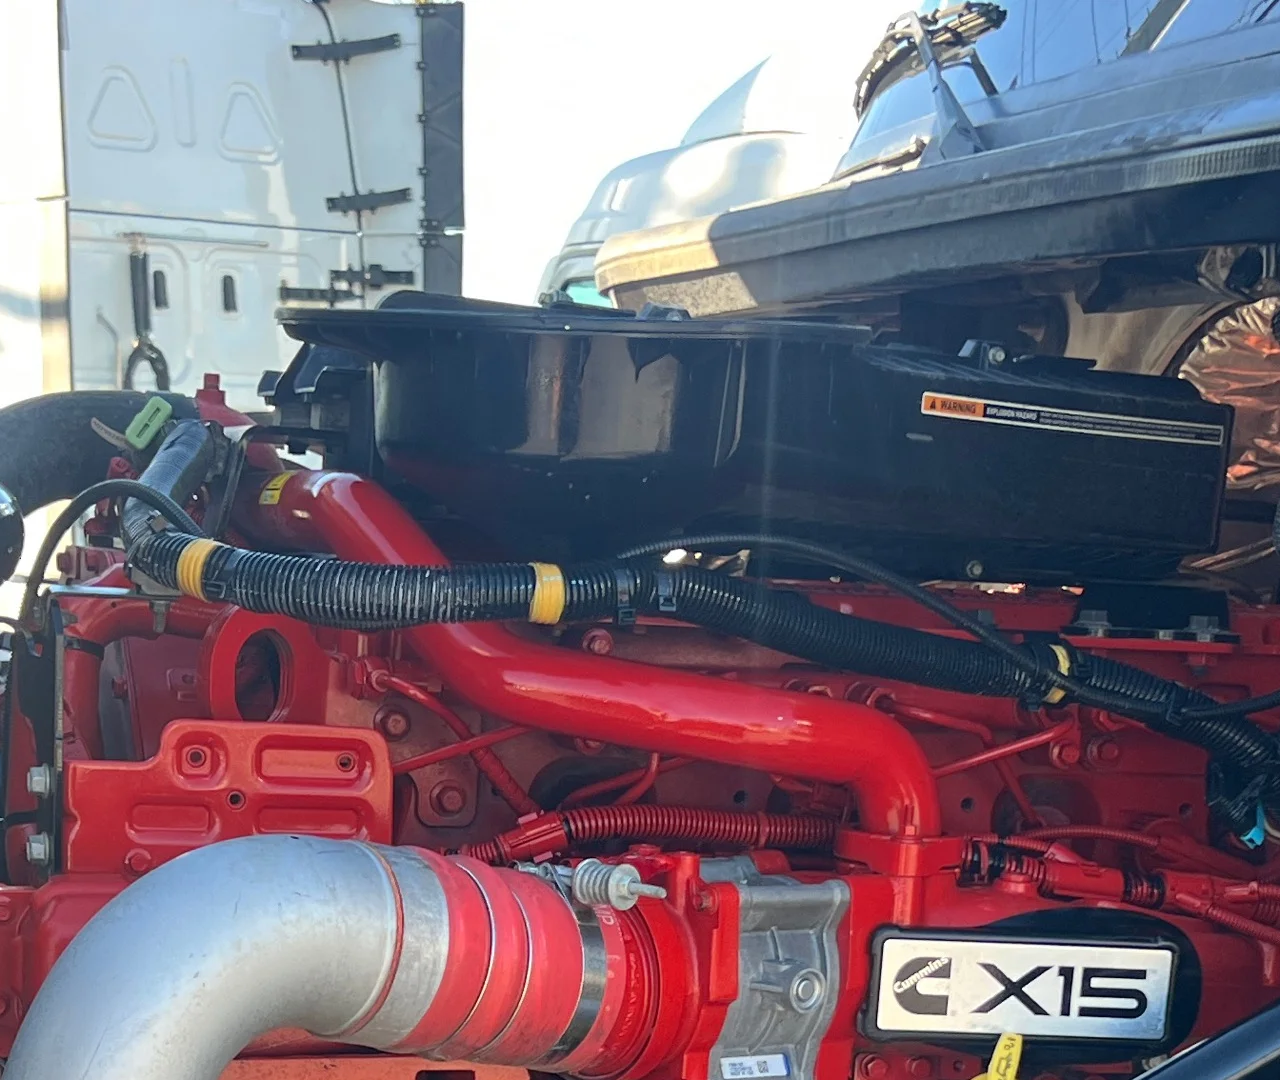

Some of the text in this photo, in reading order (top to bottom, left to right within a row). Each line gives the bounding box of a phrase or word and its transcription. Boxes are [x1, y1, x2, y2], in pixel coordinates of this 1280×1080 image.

[940, 400, 976, 414] WARNING
[893, 955, 1148, 1019] Cummins X15
